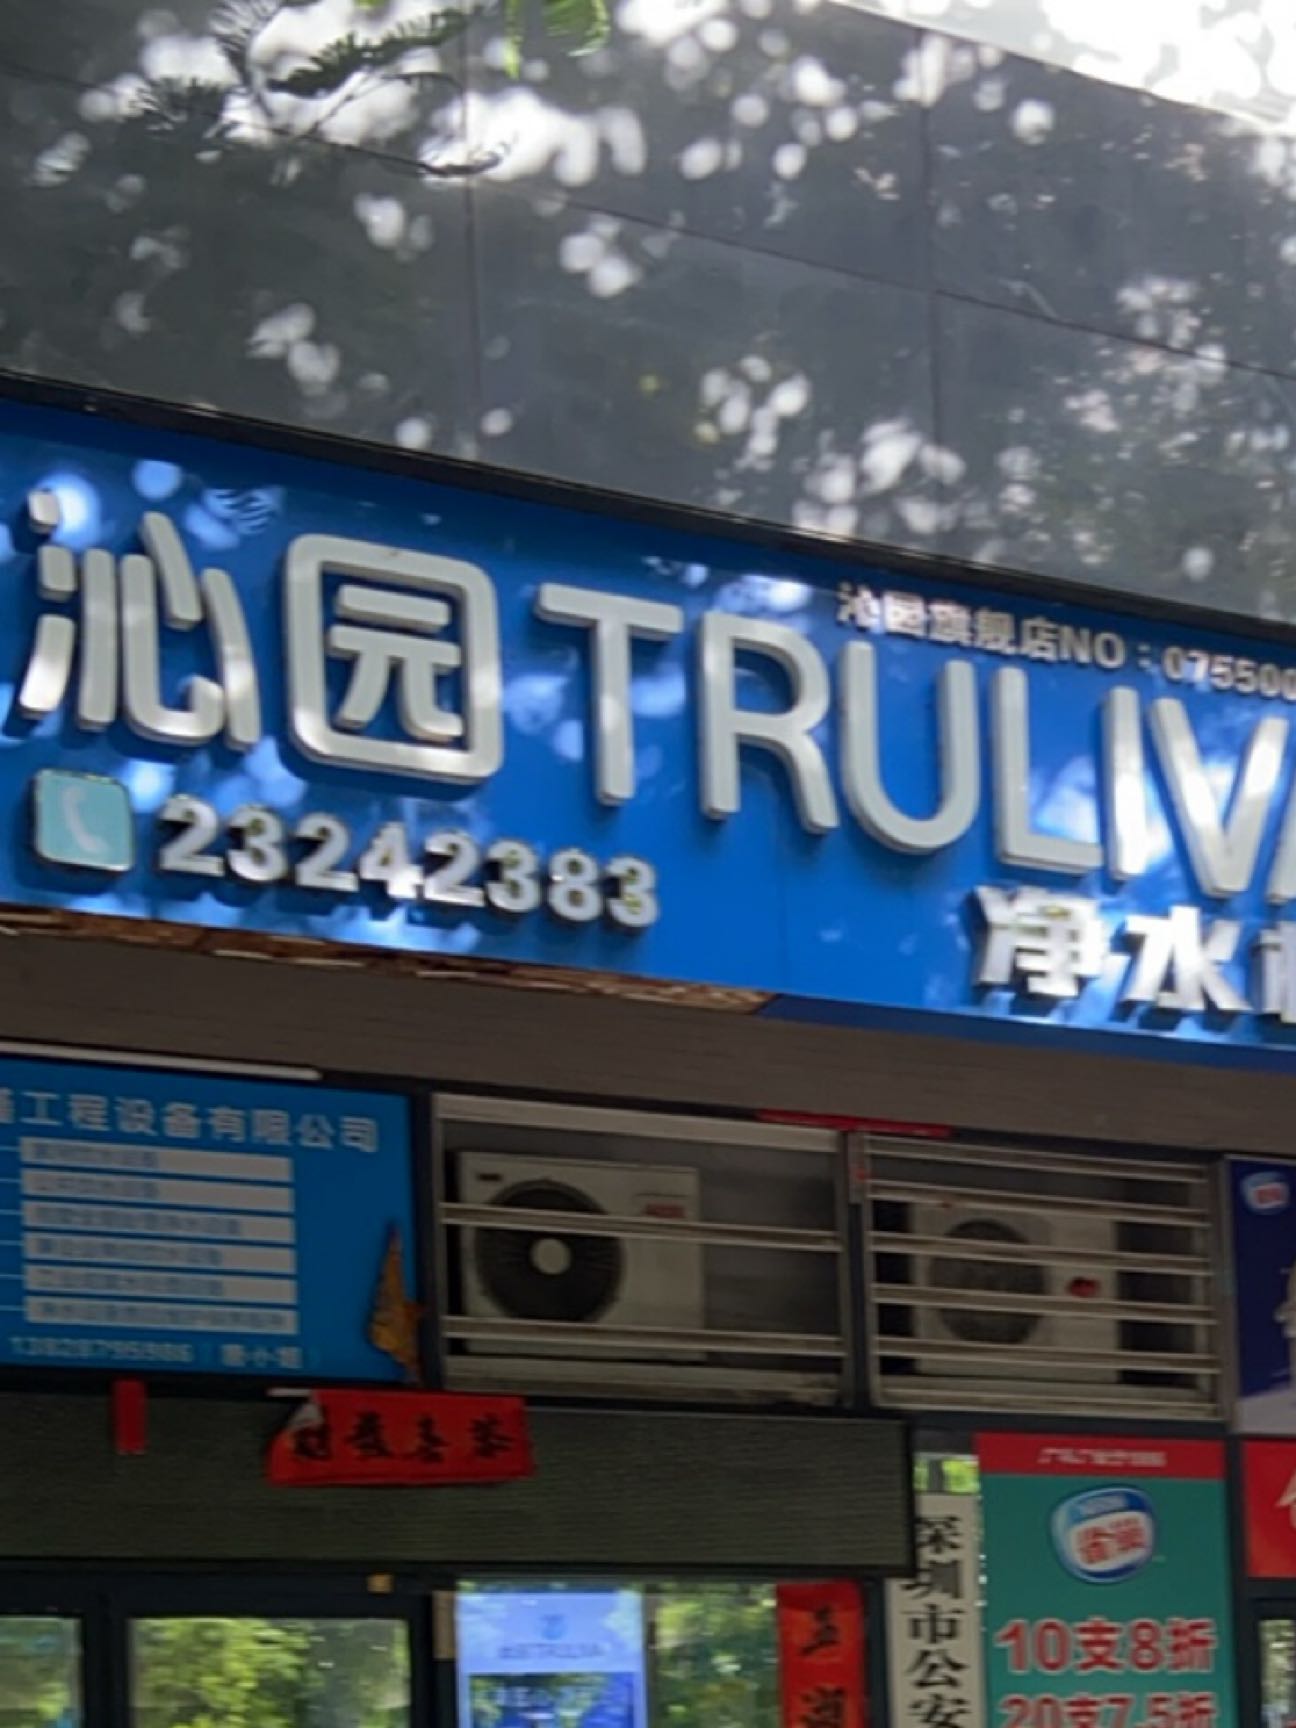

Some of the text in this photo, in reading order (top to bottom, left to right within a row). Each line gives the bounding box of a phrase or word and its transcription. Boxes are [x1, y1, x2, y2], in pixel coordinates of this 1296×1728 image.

[20, 488, 504, 784] 沁园
[157, 794, 660, 933] 23242383
[995, 1616, 1217, 1675] 10支8折
